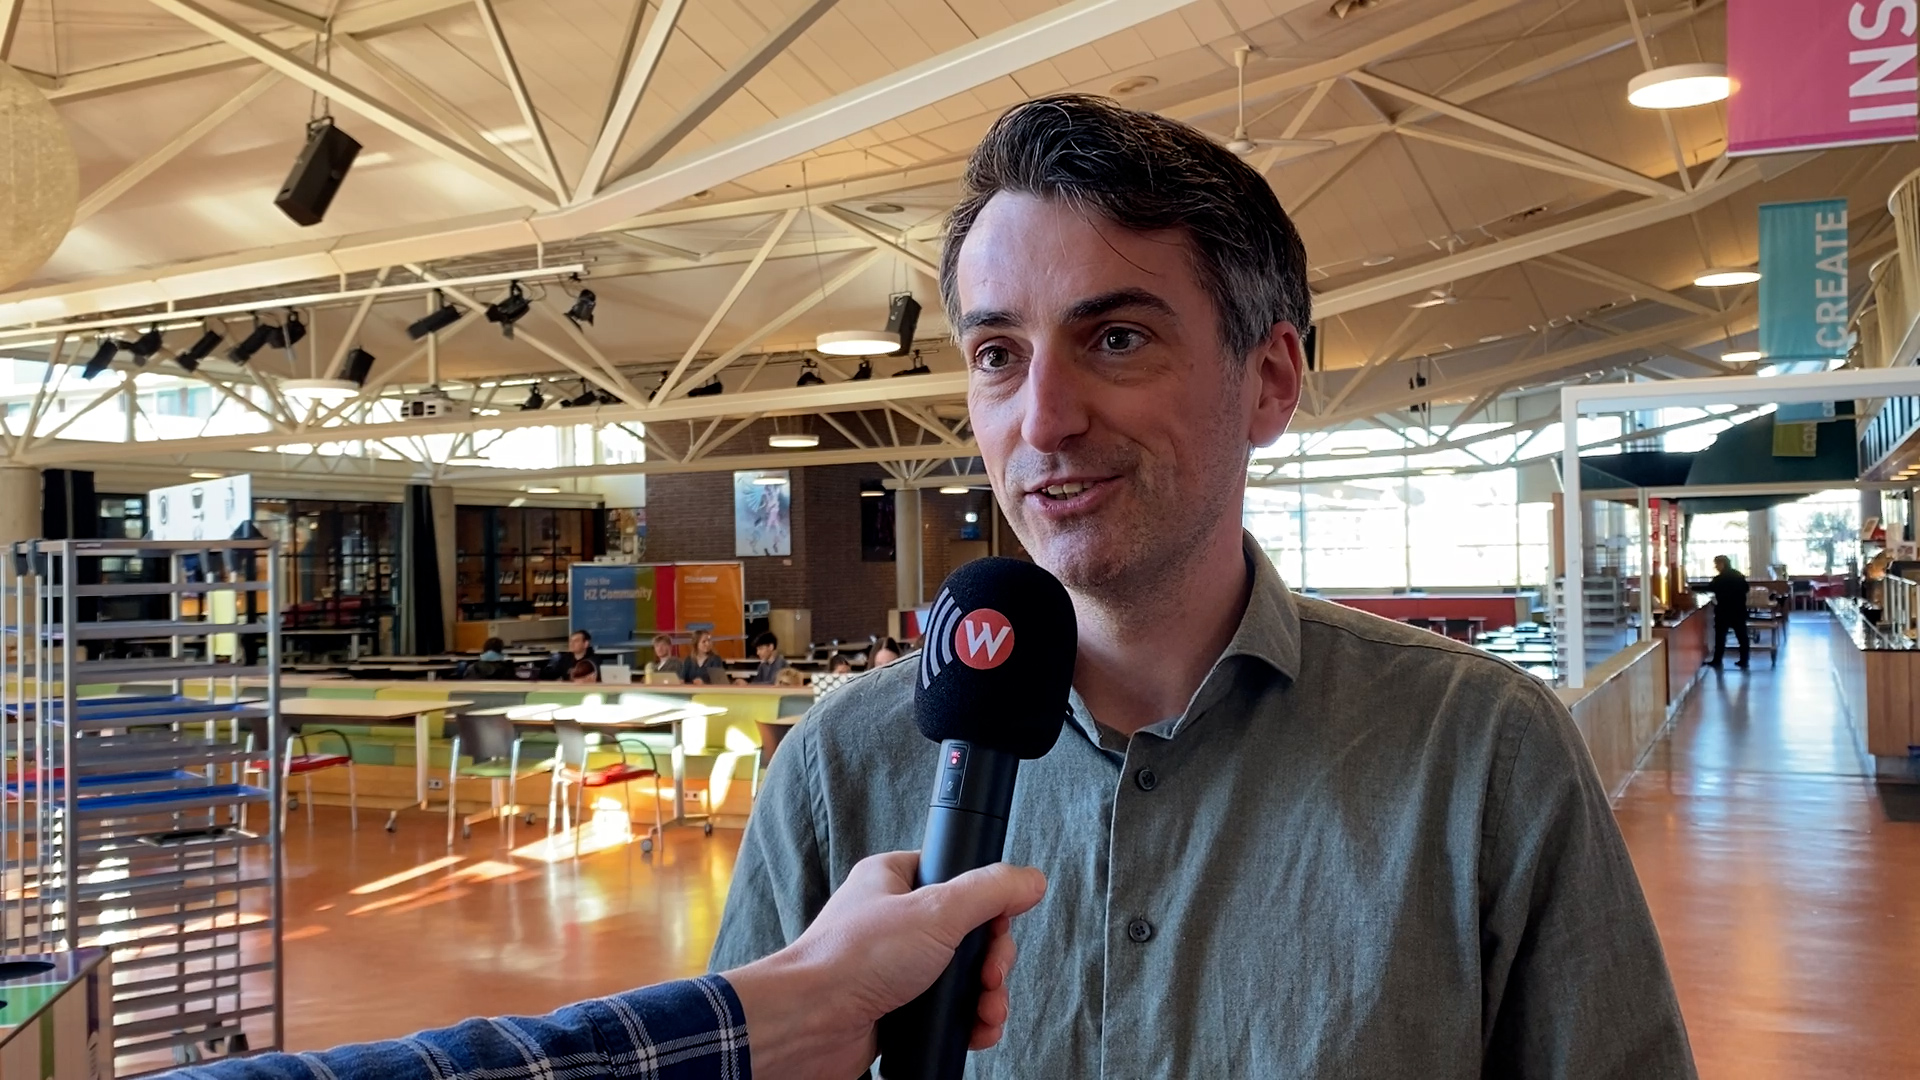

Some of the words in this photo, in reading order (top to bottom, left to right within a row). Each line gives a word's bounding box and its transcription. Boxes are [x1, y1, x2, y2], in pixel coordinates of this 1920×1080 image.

[1816, 210, 1848, 348] CREATE
[584, 589, 598, 601] HZ
[600, 587, 653, 601] Community
[964, 619, 1012, 662] W
